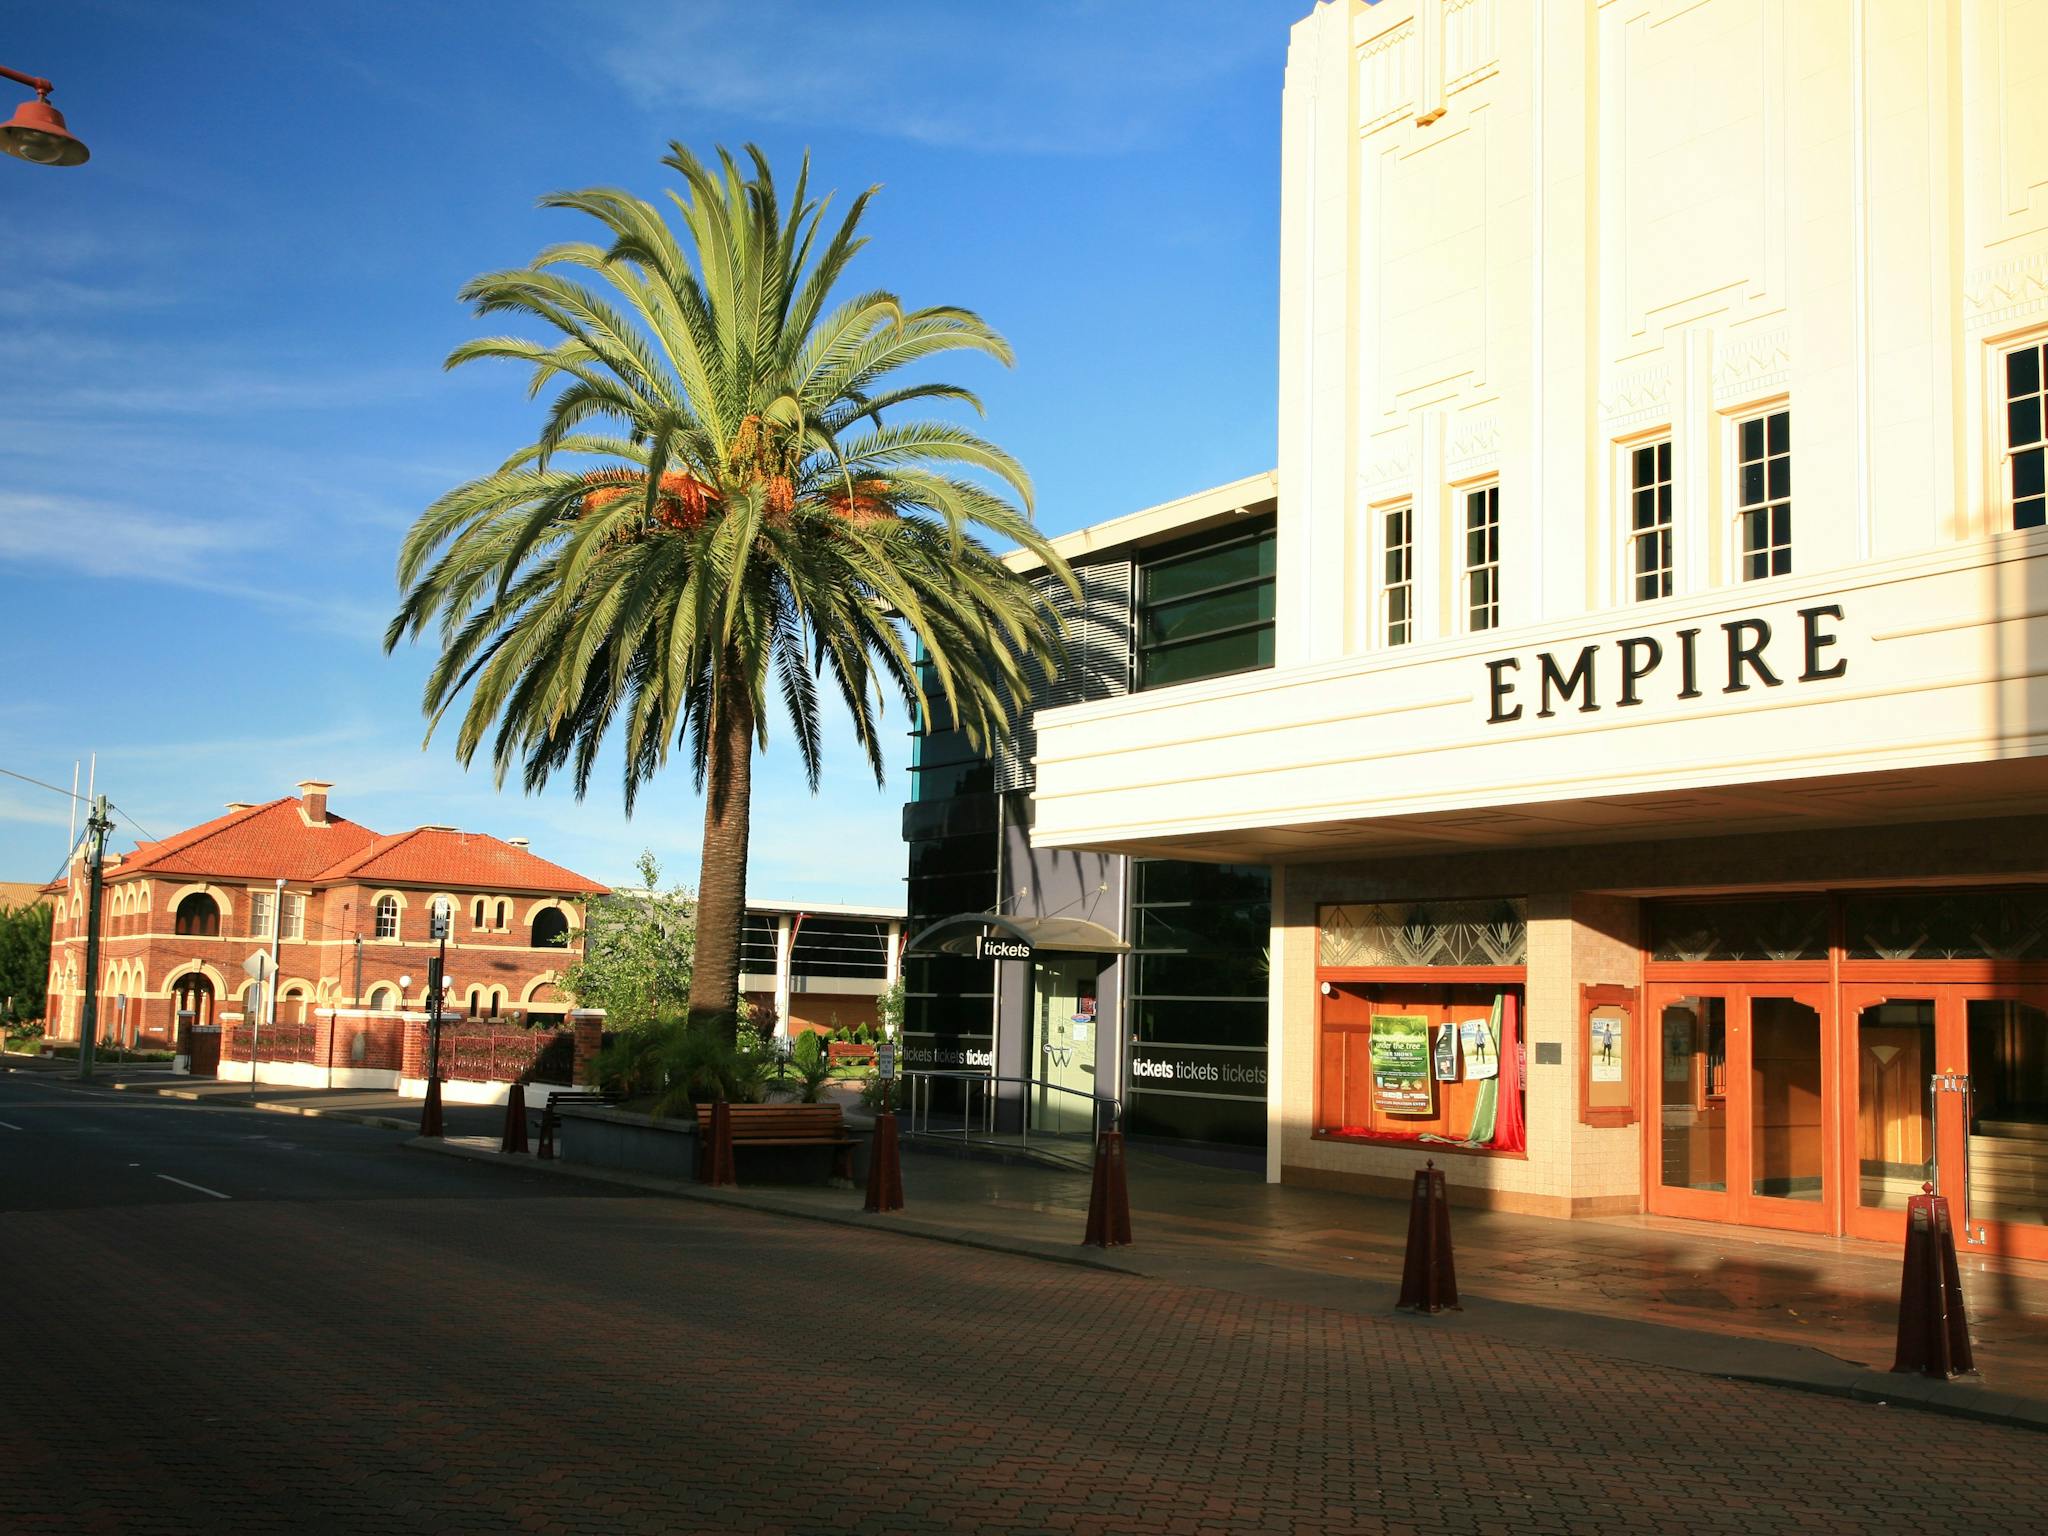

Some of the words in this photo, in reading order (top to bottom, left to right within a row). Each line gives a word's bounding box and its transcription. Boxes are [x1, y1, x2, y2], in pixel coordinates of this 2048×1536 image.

[1486, 604, 1848, 725] EMPIRE
[984, 941, 1030, 957] tickets
[903, 1046, 932, 1062] tickets
[934, 1047, 964, 1065] tickets
[1132, 1058, 1174, 1079] tickets
[1176, 1061, 1219, 1081] tickets
[1222, 1064, 1267, 1084] tickets
